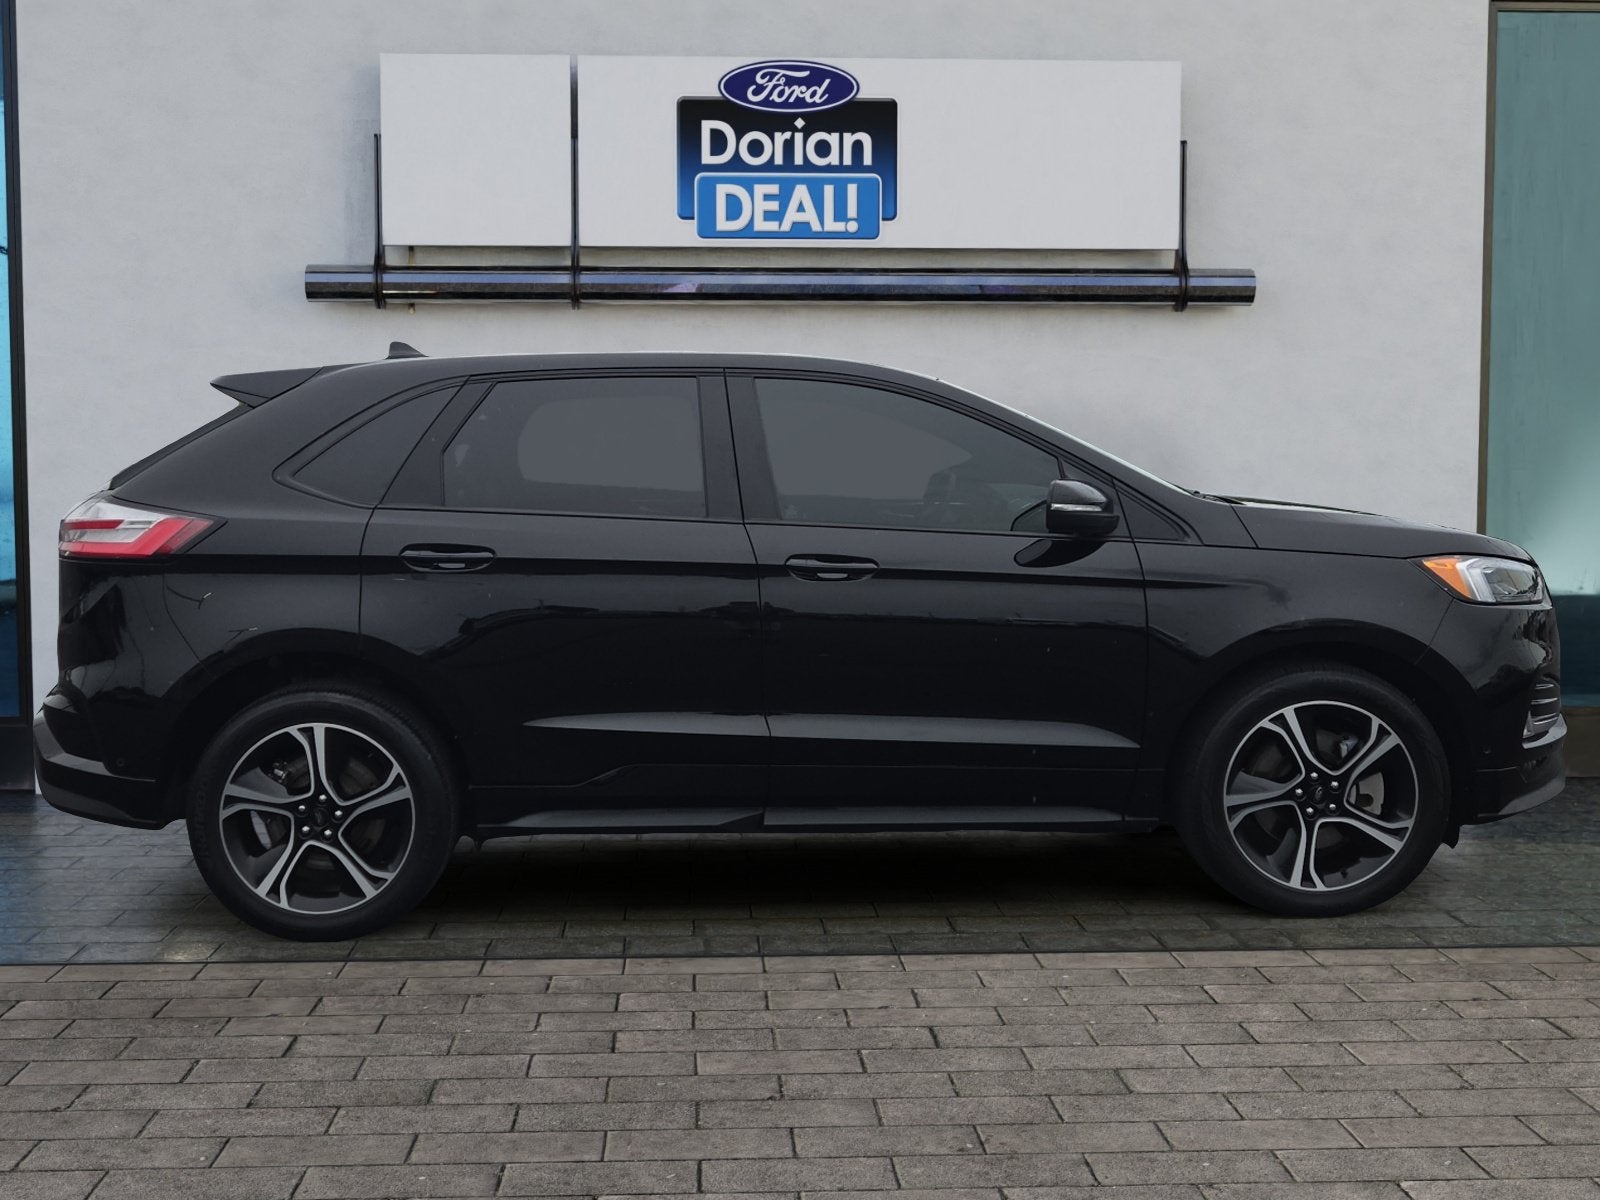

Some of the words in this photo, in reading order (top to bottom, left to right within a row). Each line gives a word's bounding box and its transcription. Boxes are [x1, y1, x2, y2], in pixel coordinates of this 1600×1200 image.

[747, 68, 831, 104] Ford
[701, 117, 873, 167] Dorian
[715, 183, 859, 233] DEAL!
